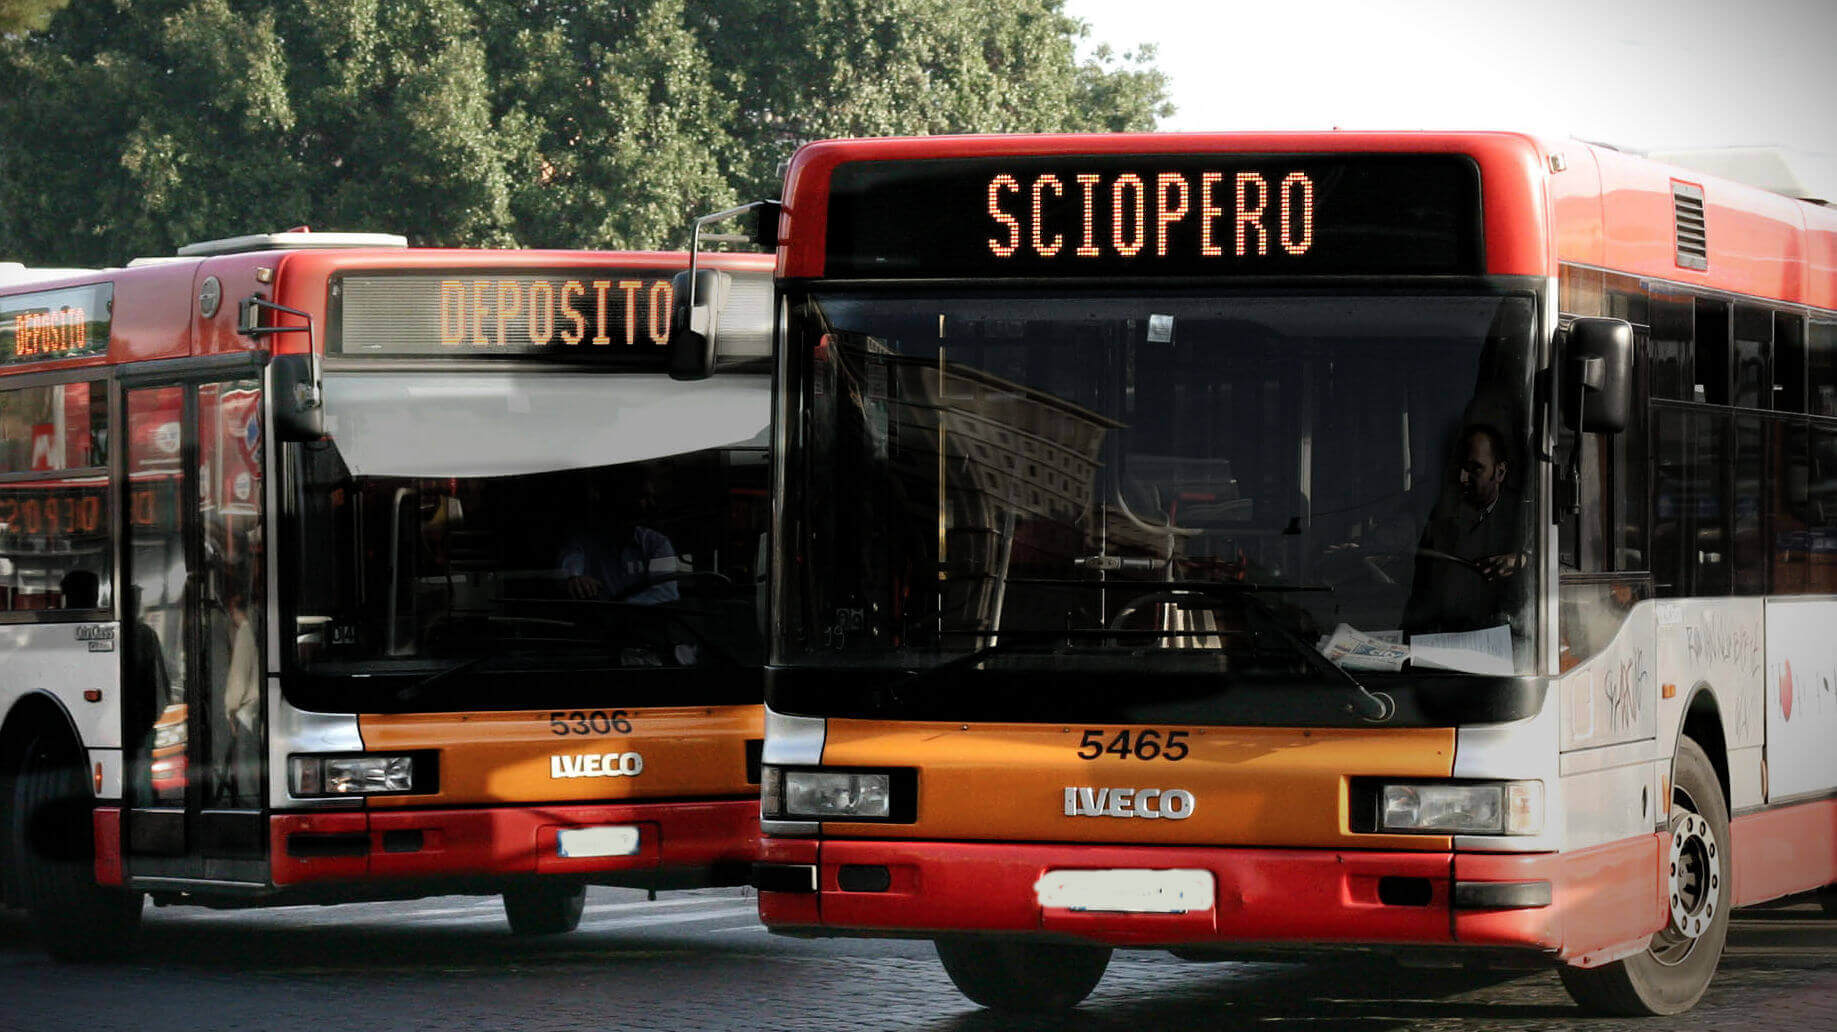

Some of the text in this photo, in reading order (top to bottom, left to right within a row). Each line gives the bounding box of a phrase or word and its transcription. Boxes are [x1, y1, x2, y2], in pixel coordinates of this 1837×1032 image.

[987, 171, 1314, 257] SCIOPERO
[439, 278, 675, 347] DEPOSITO
[15, 307, 86, 357] DEPOSITO
[550, 708, 633, 737] 5306
[1077, 728, 1190, 762] 5465
[550, 751, 644, 779] IVECO
[1063, 786, 1196, 820] IVECO
